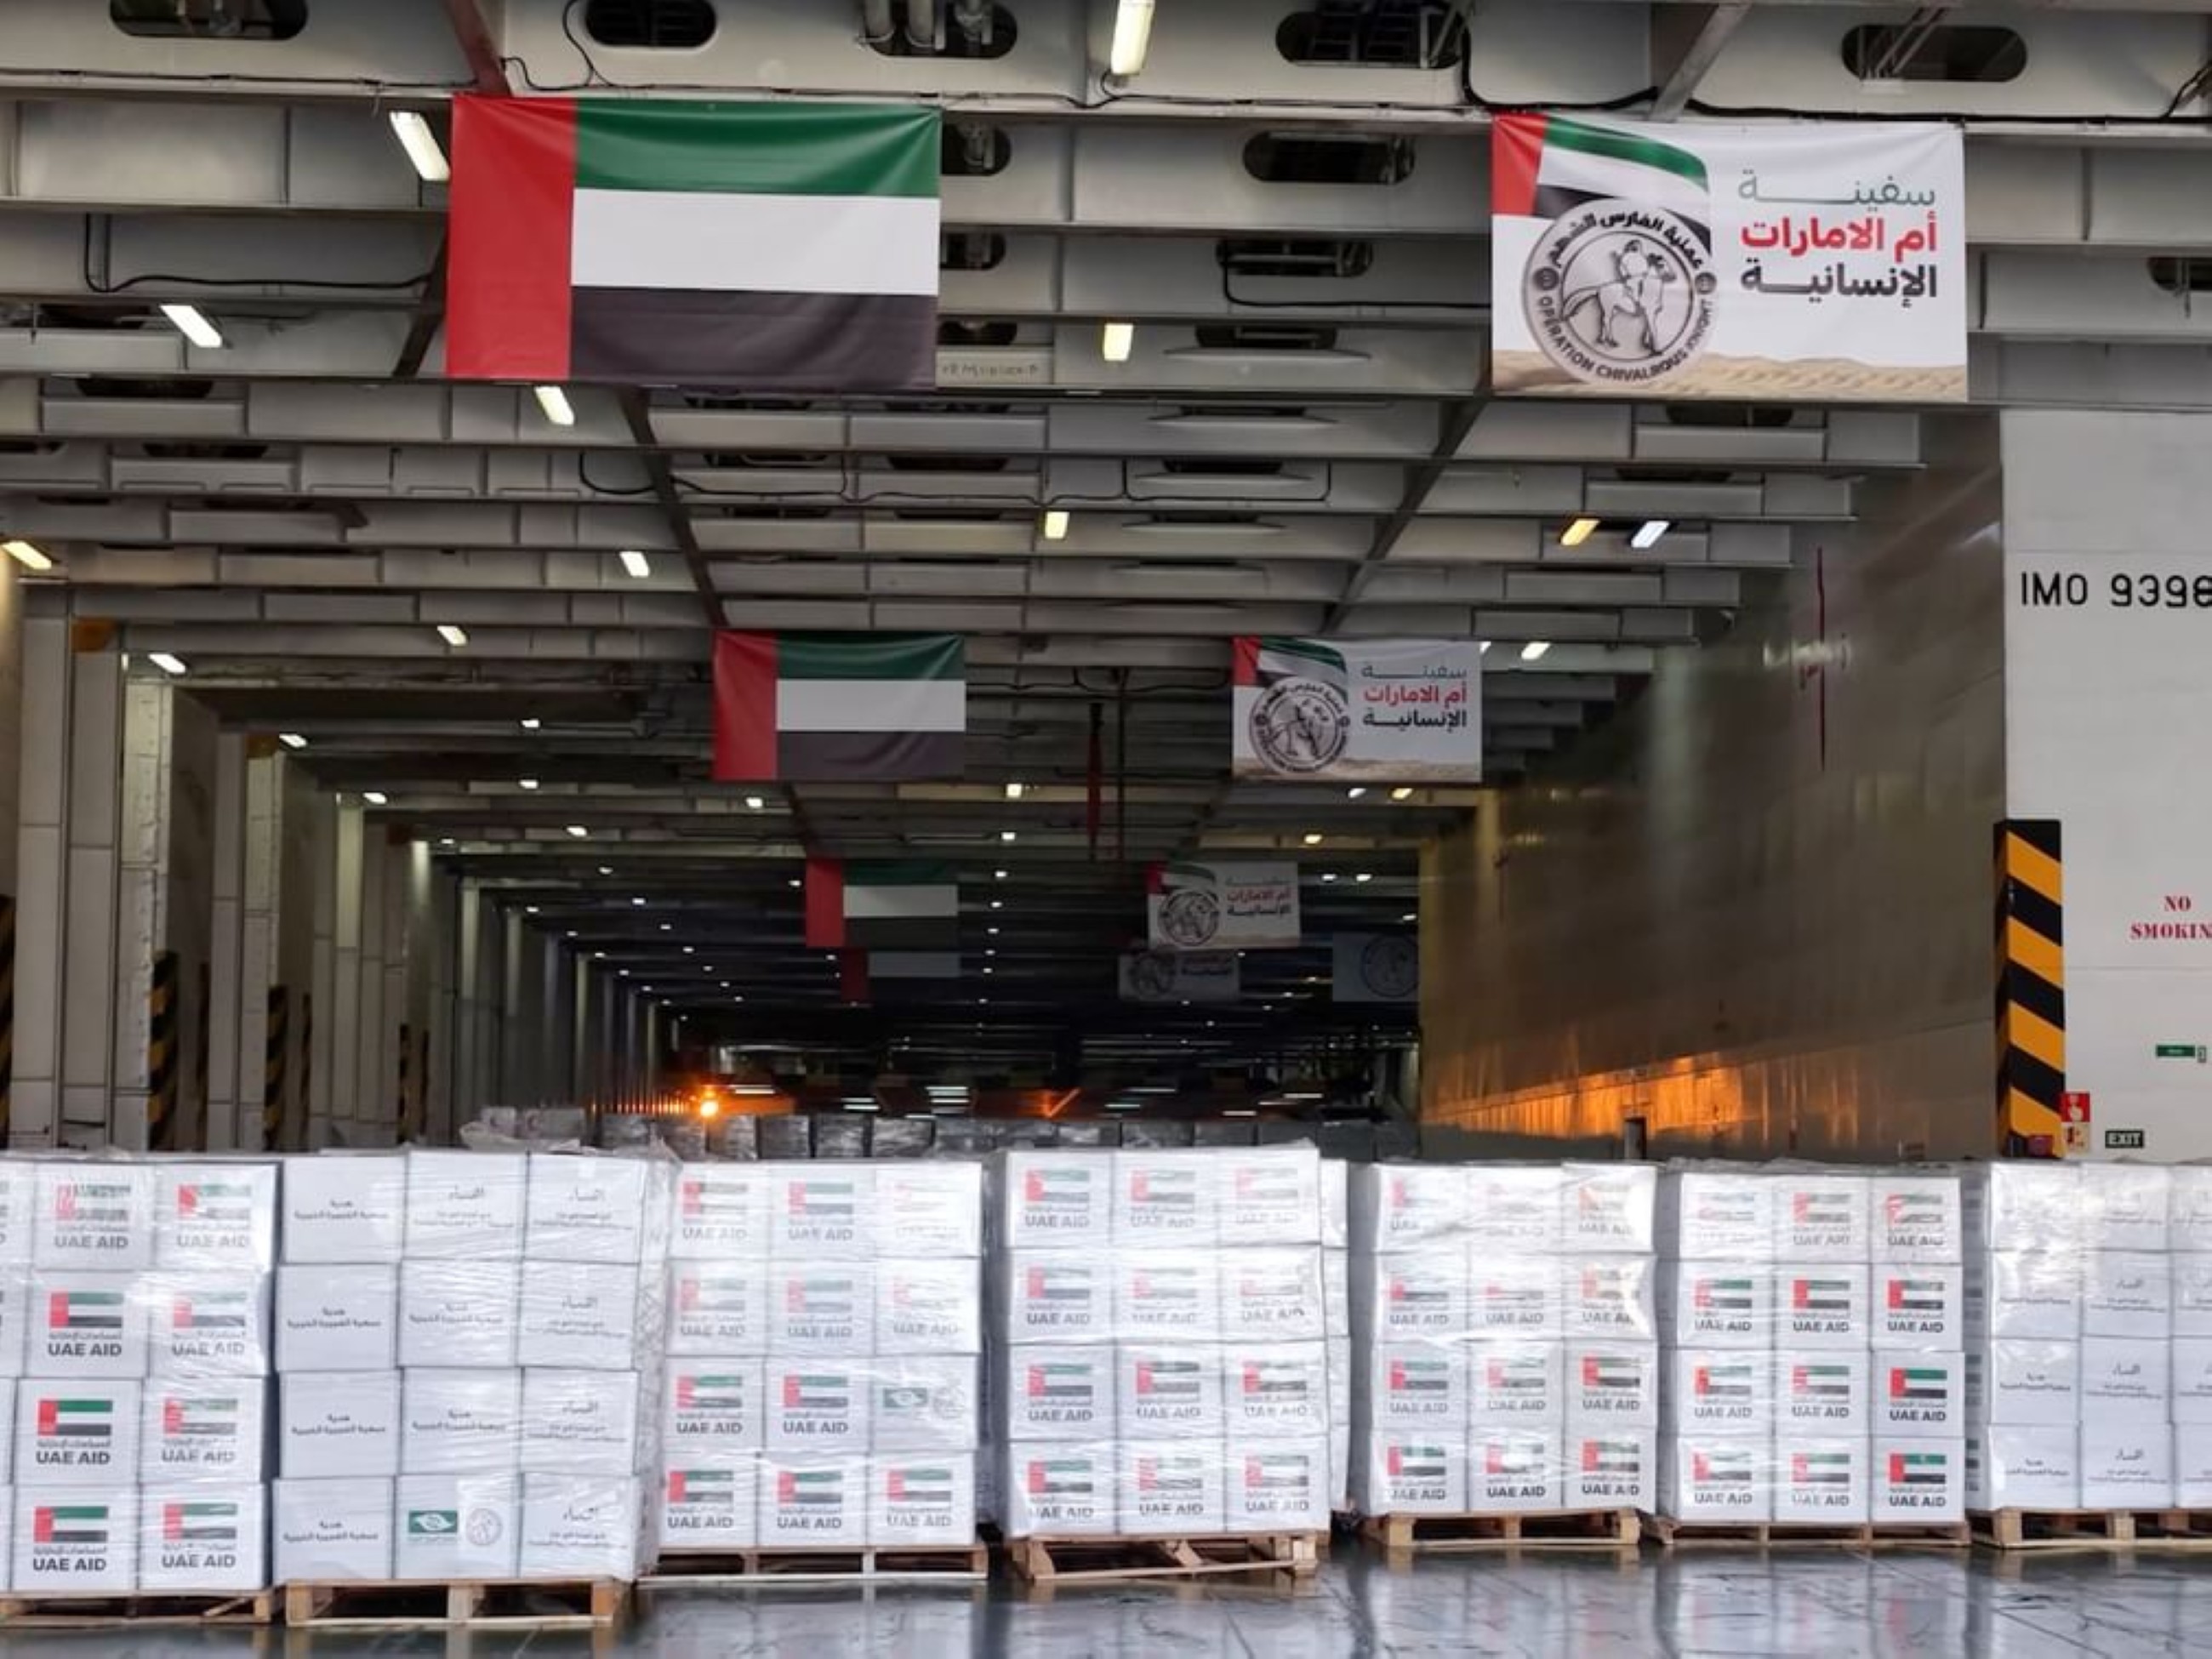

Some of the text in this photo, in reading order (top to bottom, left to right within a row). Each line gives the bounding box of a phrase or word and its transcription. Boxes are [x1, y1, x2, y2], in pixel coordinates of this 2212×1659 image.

[1738, 169, 1936, 212] سفينة
[1894, 212, 1937, 262] أم
[1740, 258, 1937, 307] الإنسانية
[1538, 296, 1595, 373] OPERATION
[1596, 350, 1689, 381] CHIVALROUS
[2021, 571, 2088, 606] IMO
[2164, 896, 2192, 912] NO
[2107, 1133, 2142, 1147] EXIT
[1024, 1215, 1057, 1229] UAE
[54, 1235, 128, 1249] UAE AID
[1887, 1235, 1916, 1246] UAE
[1026, 1312, 1091, 1325] UAE AID
[1390, 1314, 1417, 1325] UAE
[1485, 1314, 1514, 1325] UAE
[1695, 1320, 1753, 1332] UAE AID
[1793, 1320, 1850, 1332] UAE AID
[1887, 1320, 1945, 1332] UAE AID
[48, 1343, 123, 1356] UAE AID
[172, 1341, 209, 1356] UAE
[1390, 1402, 1448, 1414] UAE AID
[1521, 1400, 1547, 1411] AID
[1582, 1400, 1640, 1411] UAE AID
[1028, 1409, 1092, 1422] UAE AID
[1695, 1407, 1753, 1419] UAE AID
[1792, 1407, 1850, 1417] UAE AID
[1890, 1411, 1947, 1421] UAE AID
[676, 1422, 744, 1434] UAE AID
[783, 1422, 849, 1434] UAE AID
[36, 1450, 111, 1465] UAE AID
[162, 1449, 199, 1463] UAE
[1421, 1489, 1446, 1501] AID
[1487, 1486, 1547, 1498] UAE AID
[1582, 1484, 1610, 1496] UAE
[1695, 1493, 1753, 1504] UAE AID
[1824, 1495, 1850, 1506] AID
[1889, 1496, 1947, 1508] UAE AID
[1139, 1502, 1203, 1516] UAE AID
[668, 1517, 733, 1530] UAE AID
[778, 1518, 842, 1530] UAE AID
[32, 1559, 107, 1572] UAE AID
[162, 1555, 237, 1567] UAE AID
